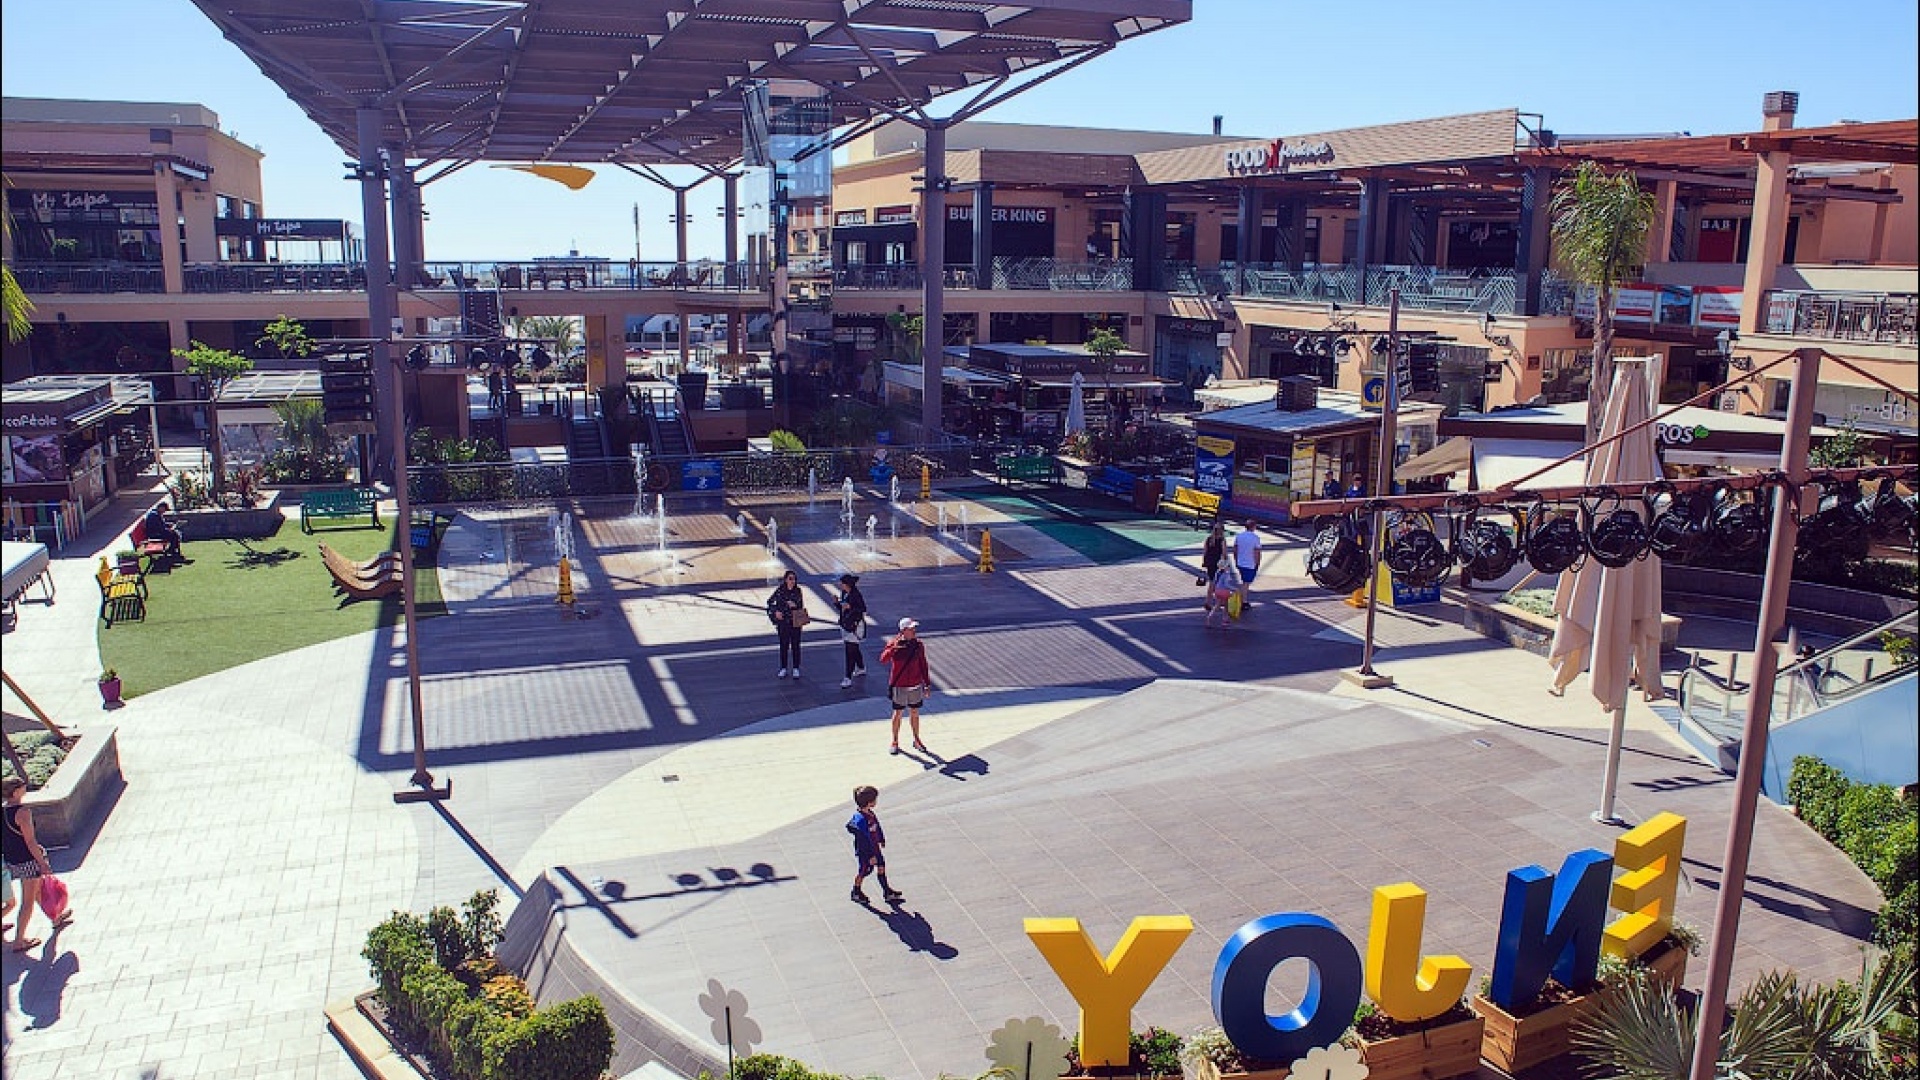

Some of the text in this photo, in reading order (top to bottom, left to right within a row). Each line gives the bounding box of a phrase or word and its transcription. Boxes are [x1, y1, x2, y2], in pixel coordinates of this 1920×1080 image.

[1225, 146, 1266, 171] FOOD
[949, 207, 1047, 223] BUER KING
